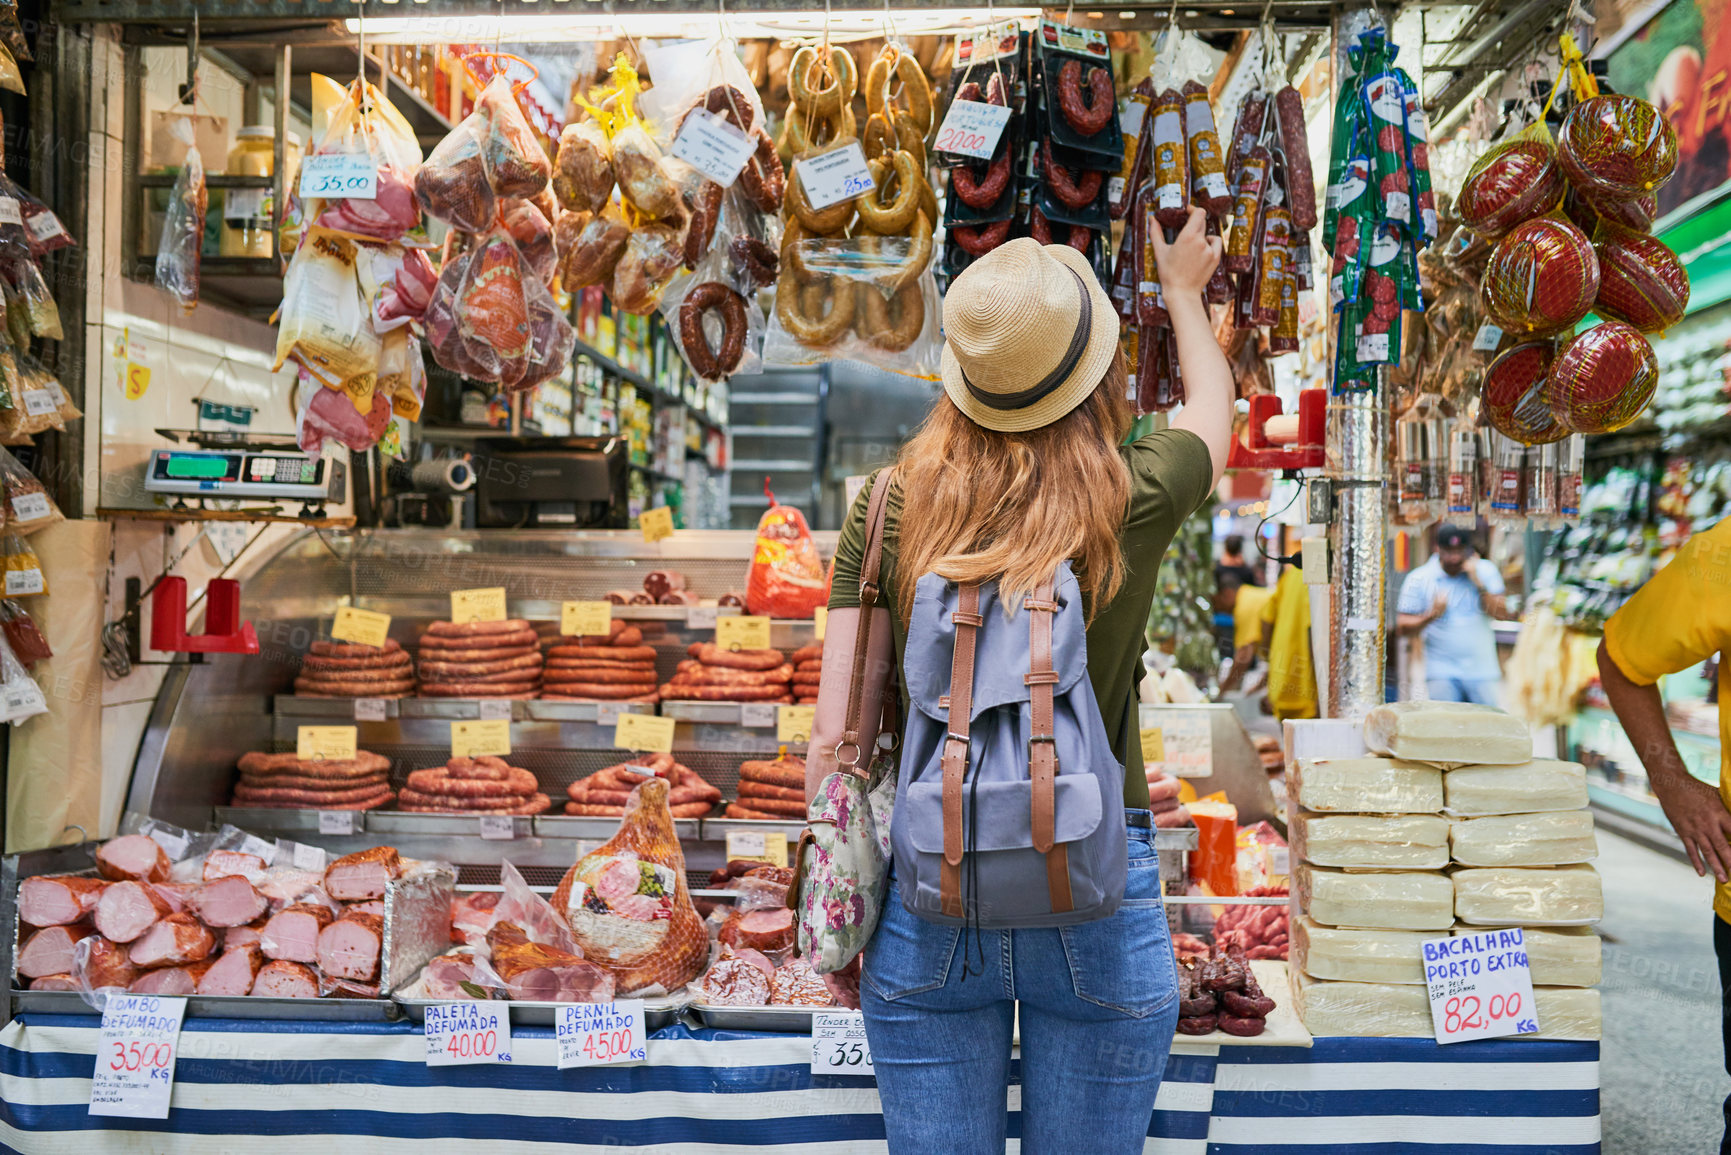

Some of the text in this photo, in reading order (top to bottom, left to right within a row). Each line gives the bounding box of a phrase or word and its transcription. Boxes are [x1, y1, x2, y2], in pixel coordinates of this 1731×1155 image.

[1423, 928, 1523, 962] BACALHAU
[1427, 951, 1529, 982] PORTO EXTRA
[107, 997, 160, 1013] LOMBO
[1431, 991, 1446, 1001] SEM
[426, 1003, 479, 1020] PALETA
[1444, 992, 1522, 1034] 82,00
[101, 1014, 177, 1033] DEFUMADO
[426, 1015, 498, 1035] DEFUMADA
[558, 1015, 634, 1036] DEFUMADO
[1516, 1018, 1538, 1033] KG
[447, 1030, 496, 1059] 40,00
[583, 1029, 632, 1062] 45,00
[630, 1047, 646, 1061] KG
[498, 1052, 512, 1062] KG
[151, 1068, 169, 1085] KG
